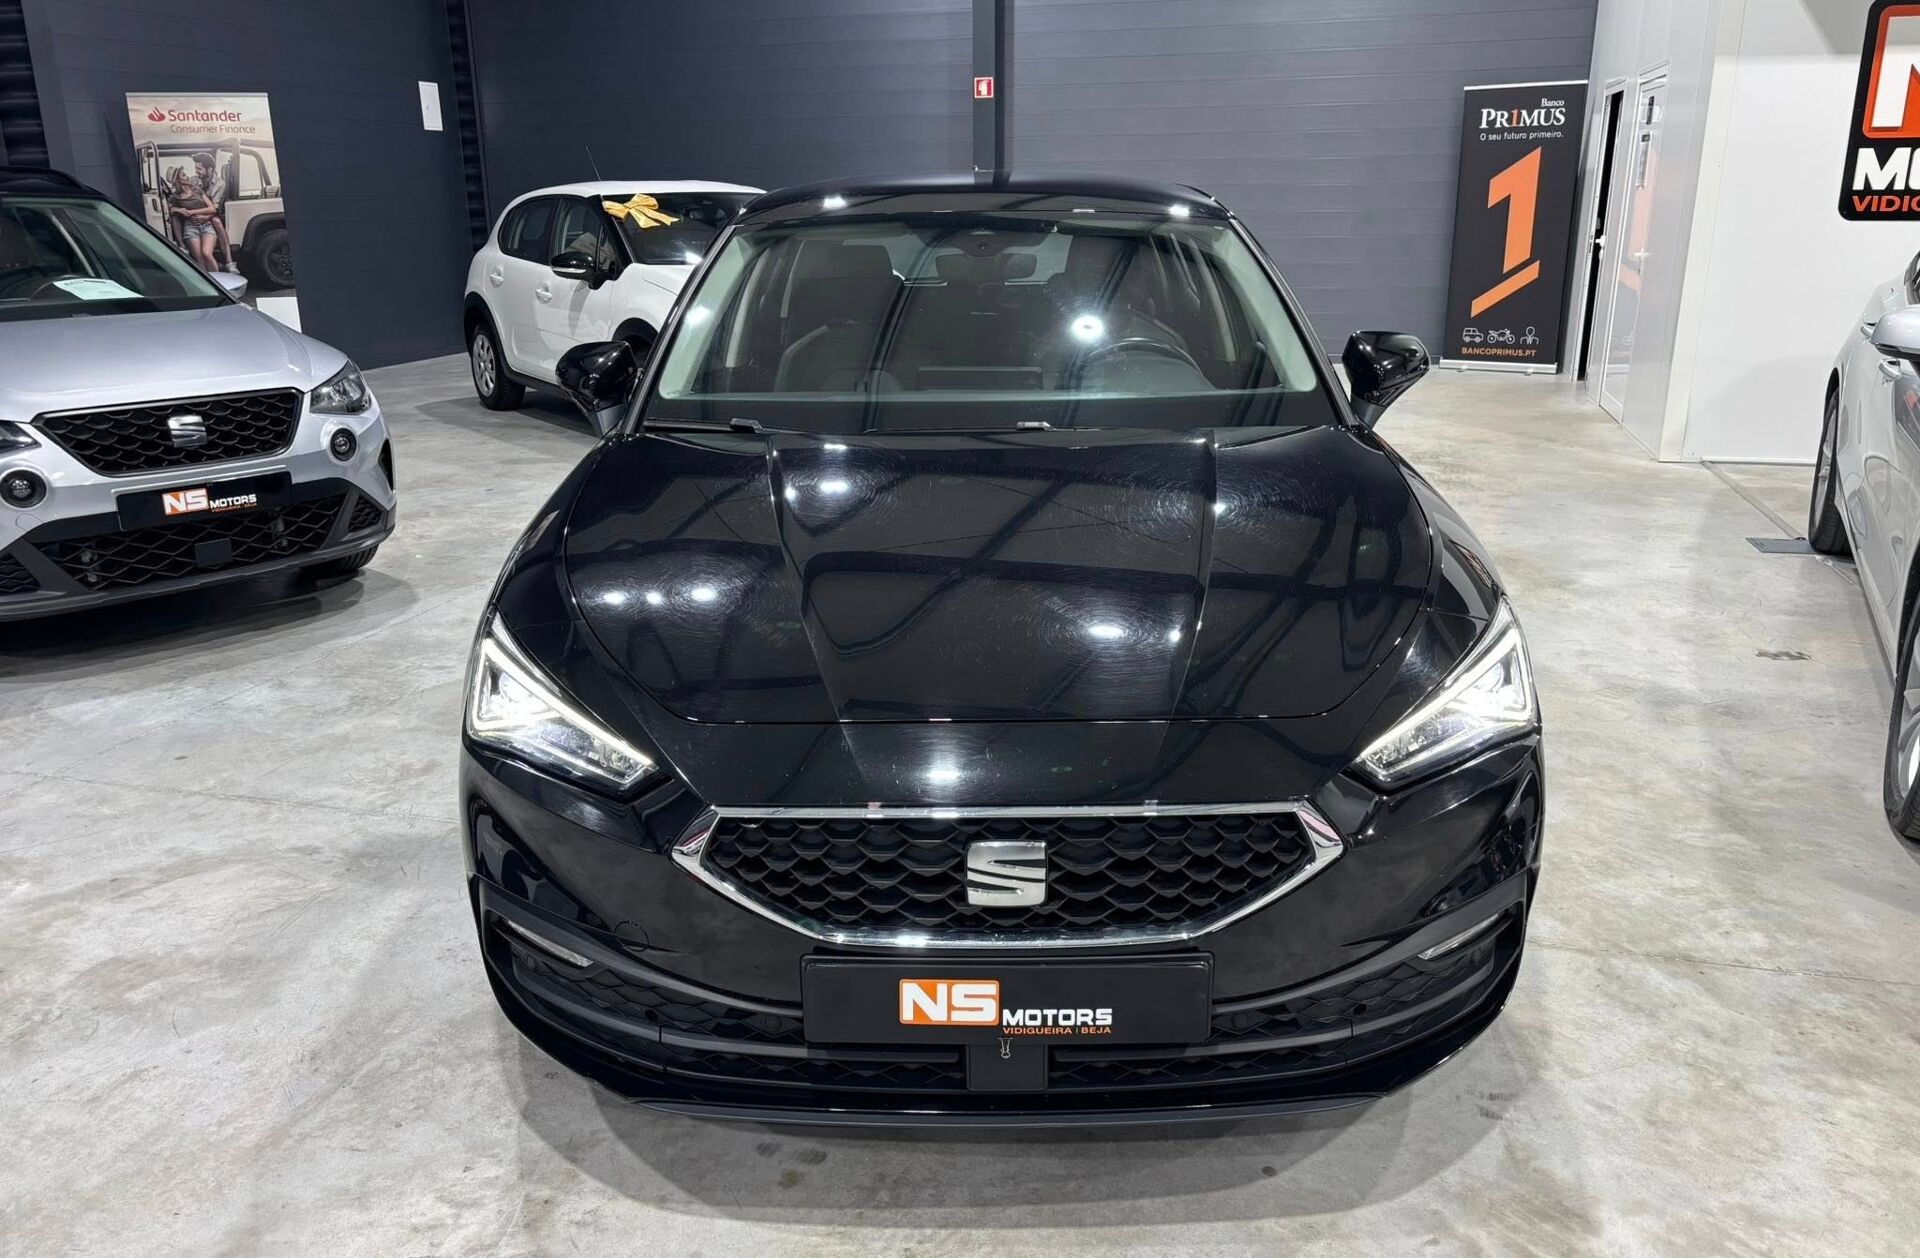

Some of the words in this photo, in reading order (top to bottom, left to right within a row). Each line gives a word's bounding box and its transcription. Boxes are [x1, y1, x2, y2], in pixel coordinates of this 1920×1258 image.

[1541, 97, 1565, 107] Banco
[168, 109, 242, 122] Santander
[170, 124, 218, 134] Consumer
[220, 124, 256, 134] Finance
[1479, 132, 1487, 141] O
[1488, 133, 1501, 141] seu
[1504, 131, 1527, 140] futuro
[1529, 130, 1564, 140] primeiro.
[1852, 147, 1920, 190] M
[1461, 346, 1537, 357] BANCOPRIMUS.PT
[162, 488, 209, 516] NS
[209, 493, 257, 509] MOTORS
[902, 982, 998, 1022] NS
[1002, 1008, 1113, 1026] MOTORS
[1003, 1026, 1073, 1035] VIDIGUEIRA
[1081, 1026, 1112, 1034] BEJA
